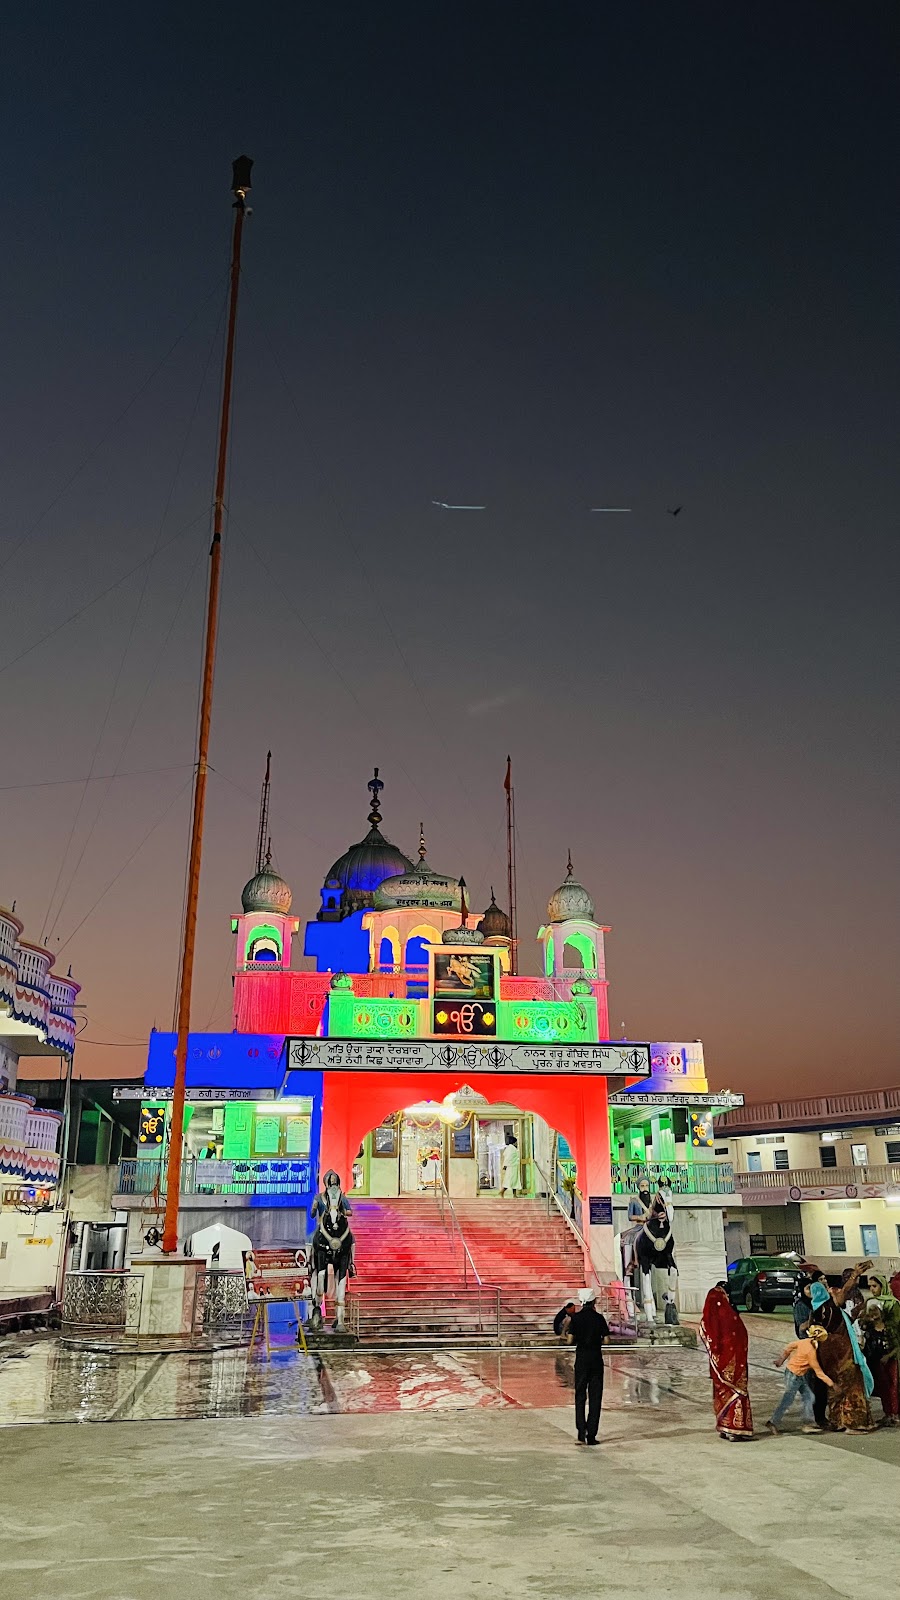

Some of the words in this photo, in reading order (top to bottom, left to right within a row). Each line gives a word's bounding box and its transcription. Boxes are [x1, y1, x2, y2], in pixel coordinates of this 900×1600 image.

[450, 1003, 484, 1034] ੴ
[523, 1049, 546, 1057] ਨਾਨਕ
[592, 1048, 610, 1058] ਸਿੰਘ
[572, 1060, 602, 1069] ਅਵਤਾਰ
[142, 1116, 164, 1134] ੴ
